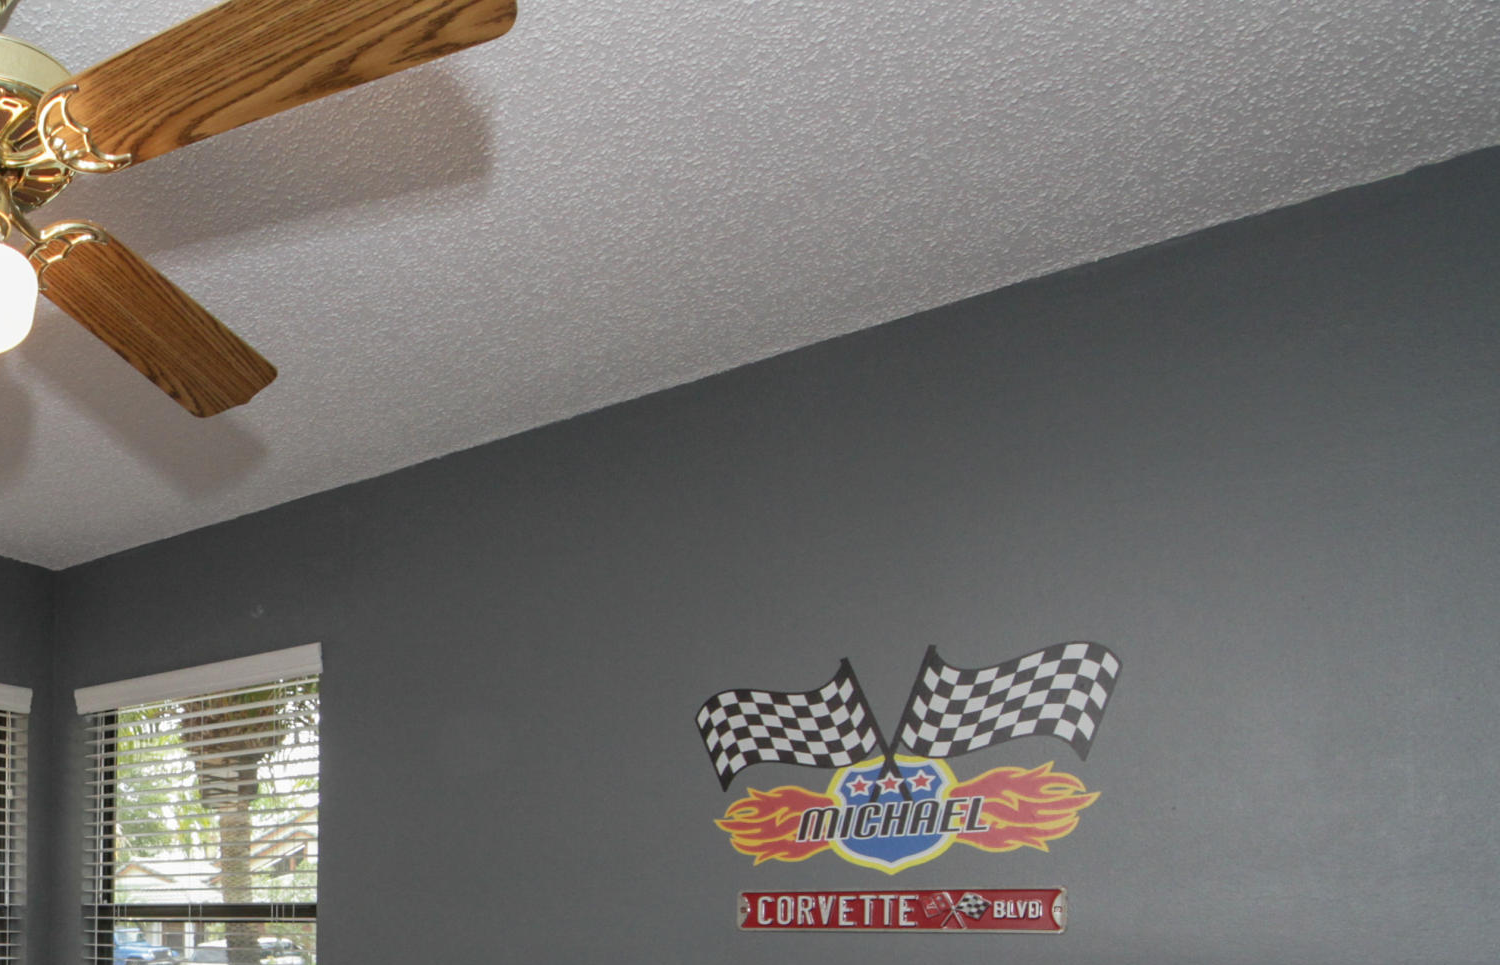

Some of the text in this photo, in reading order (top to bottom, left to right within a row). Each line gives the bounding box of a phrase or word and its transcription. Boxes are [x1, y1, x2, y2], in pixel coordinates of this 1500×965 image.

[795, 796, 990, 843] MICHAEL
[757, 895, 1043, 926] CORVETTE BLVD
